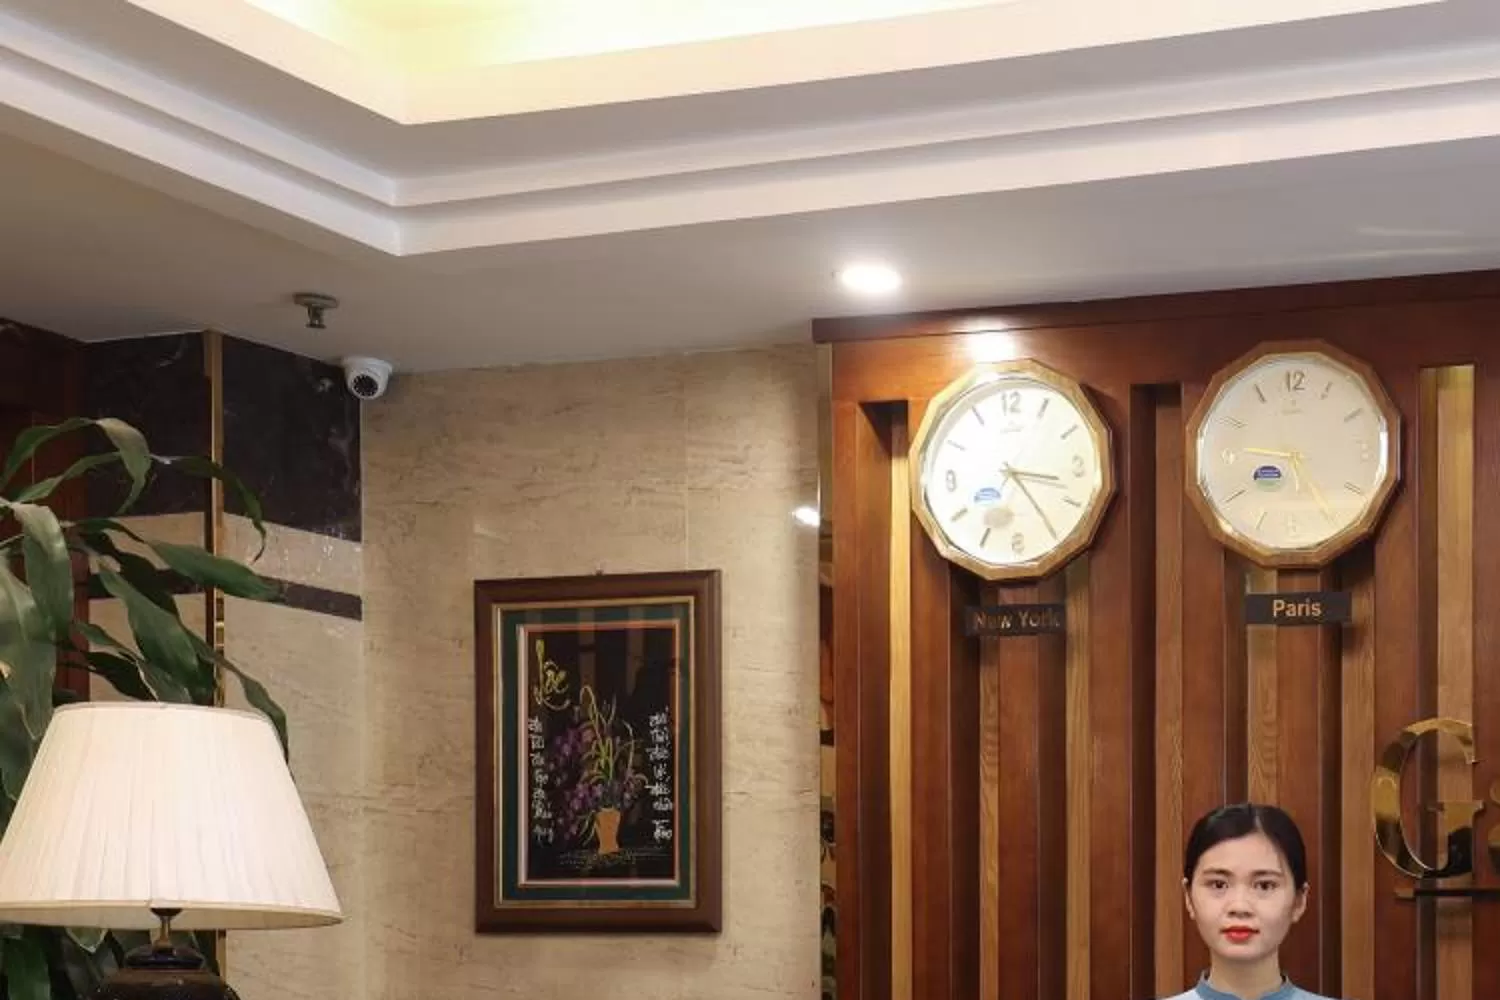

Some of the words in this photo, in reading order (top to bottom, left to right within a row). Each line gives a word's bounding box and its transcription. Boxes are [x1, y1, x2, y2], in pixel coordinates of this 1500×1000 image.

[1285, 371, 1306, 392] 12
[1002, 391, 1022, 415] 12
[1272, 599, 1322, 618] Paris
